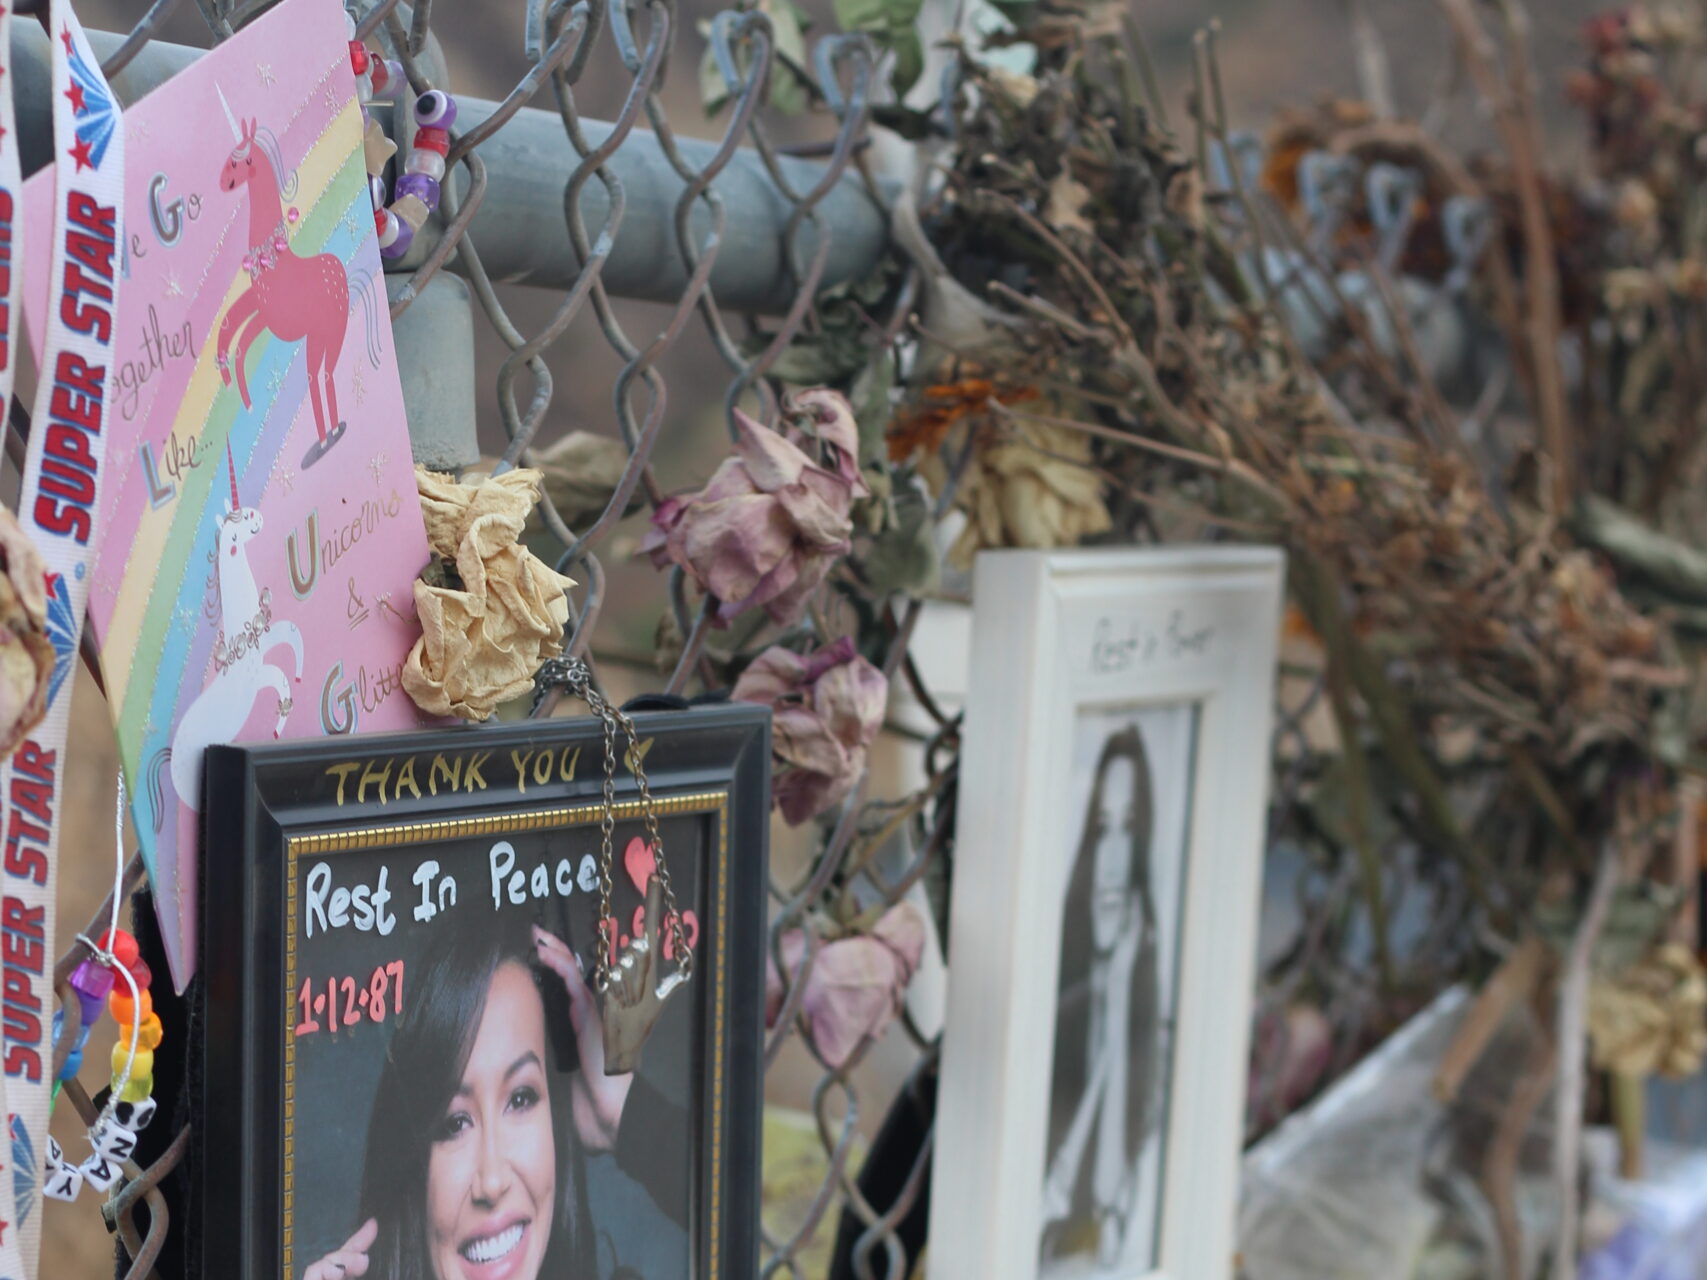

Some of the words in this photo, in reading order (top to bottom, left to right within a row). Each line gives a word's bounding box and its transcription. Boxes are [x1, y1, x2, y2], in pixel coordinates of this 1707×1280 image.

[59, 188, 116, 346] STAR
[148, 172, 203, 249] Go
[110, 303, 197, 421] ogether
[34, 351, 106, 546] SUPER
[285, 488, 402, 601] Unicorns
[319, 660, 405, 735] Glitte
[4, 738, 57, 888] STAR
[326, 752, 490, 806] THANK
[511, 746, 581, 794] YOU
[304, 861, 396, 938] Rest
[412, 859, 456, 922] In
[489, 840, 599, 911] Peace
[1, 895, 46, 1085] SUPER
